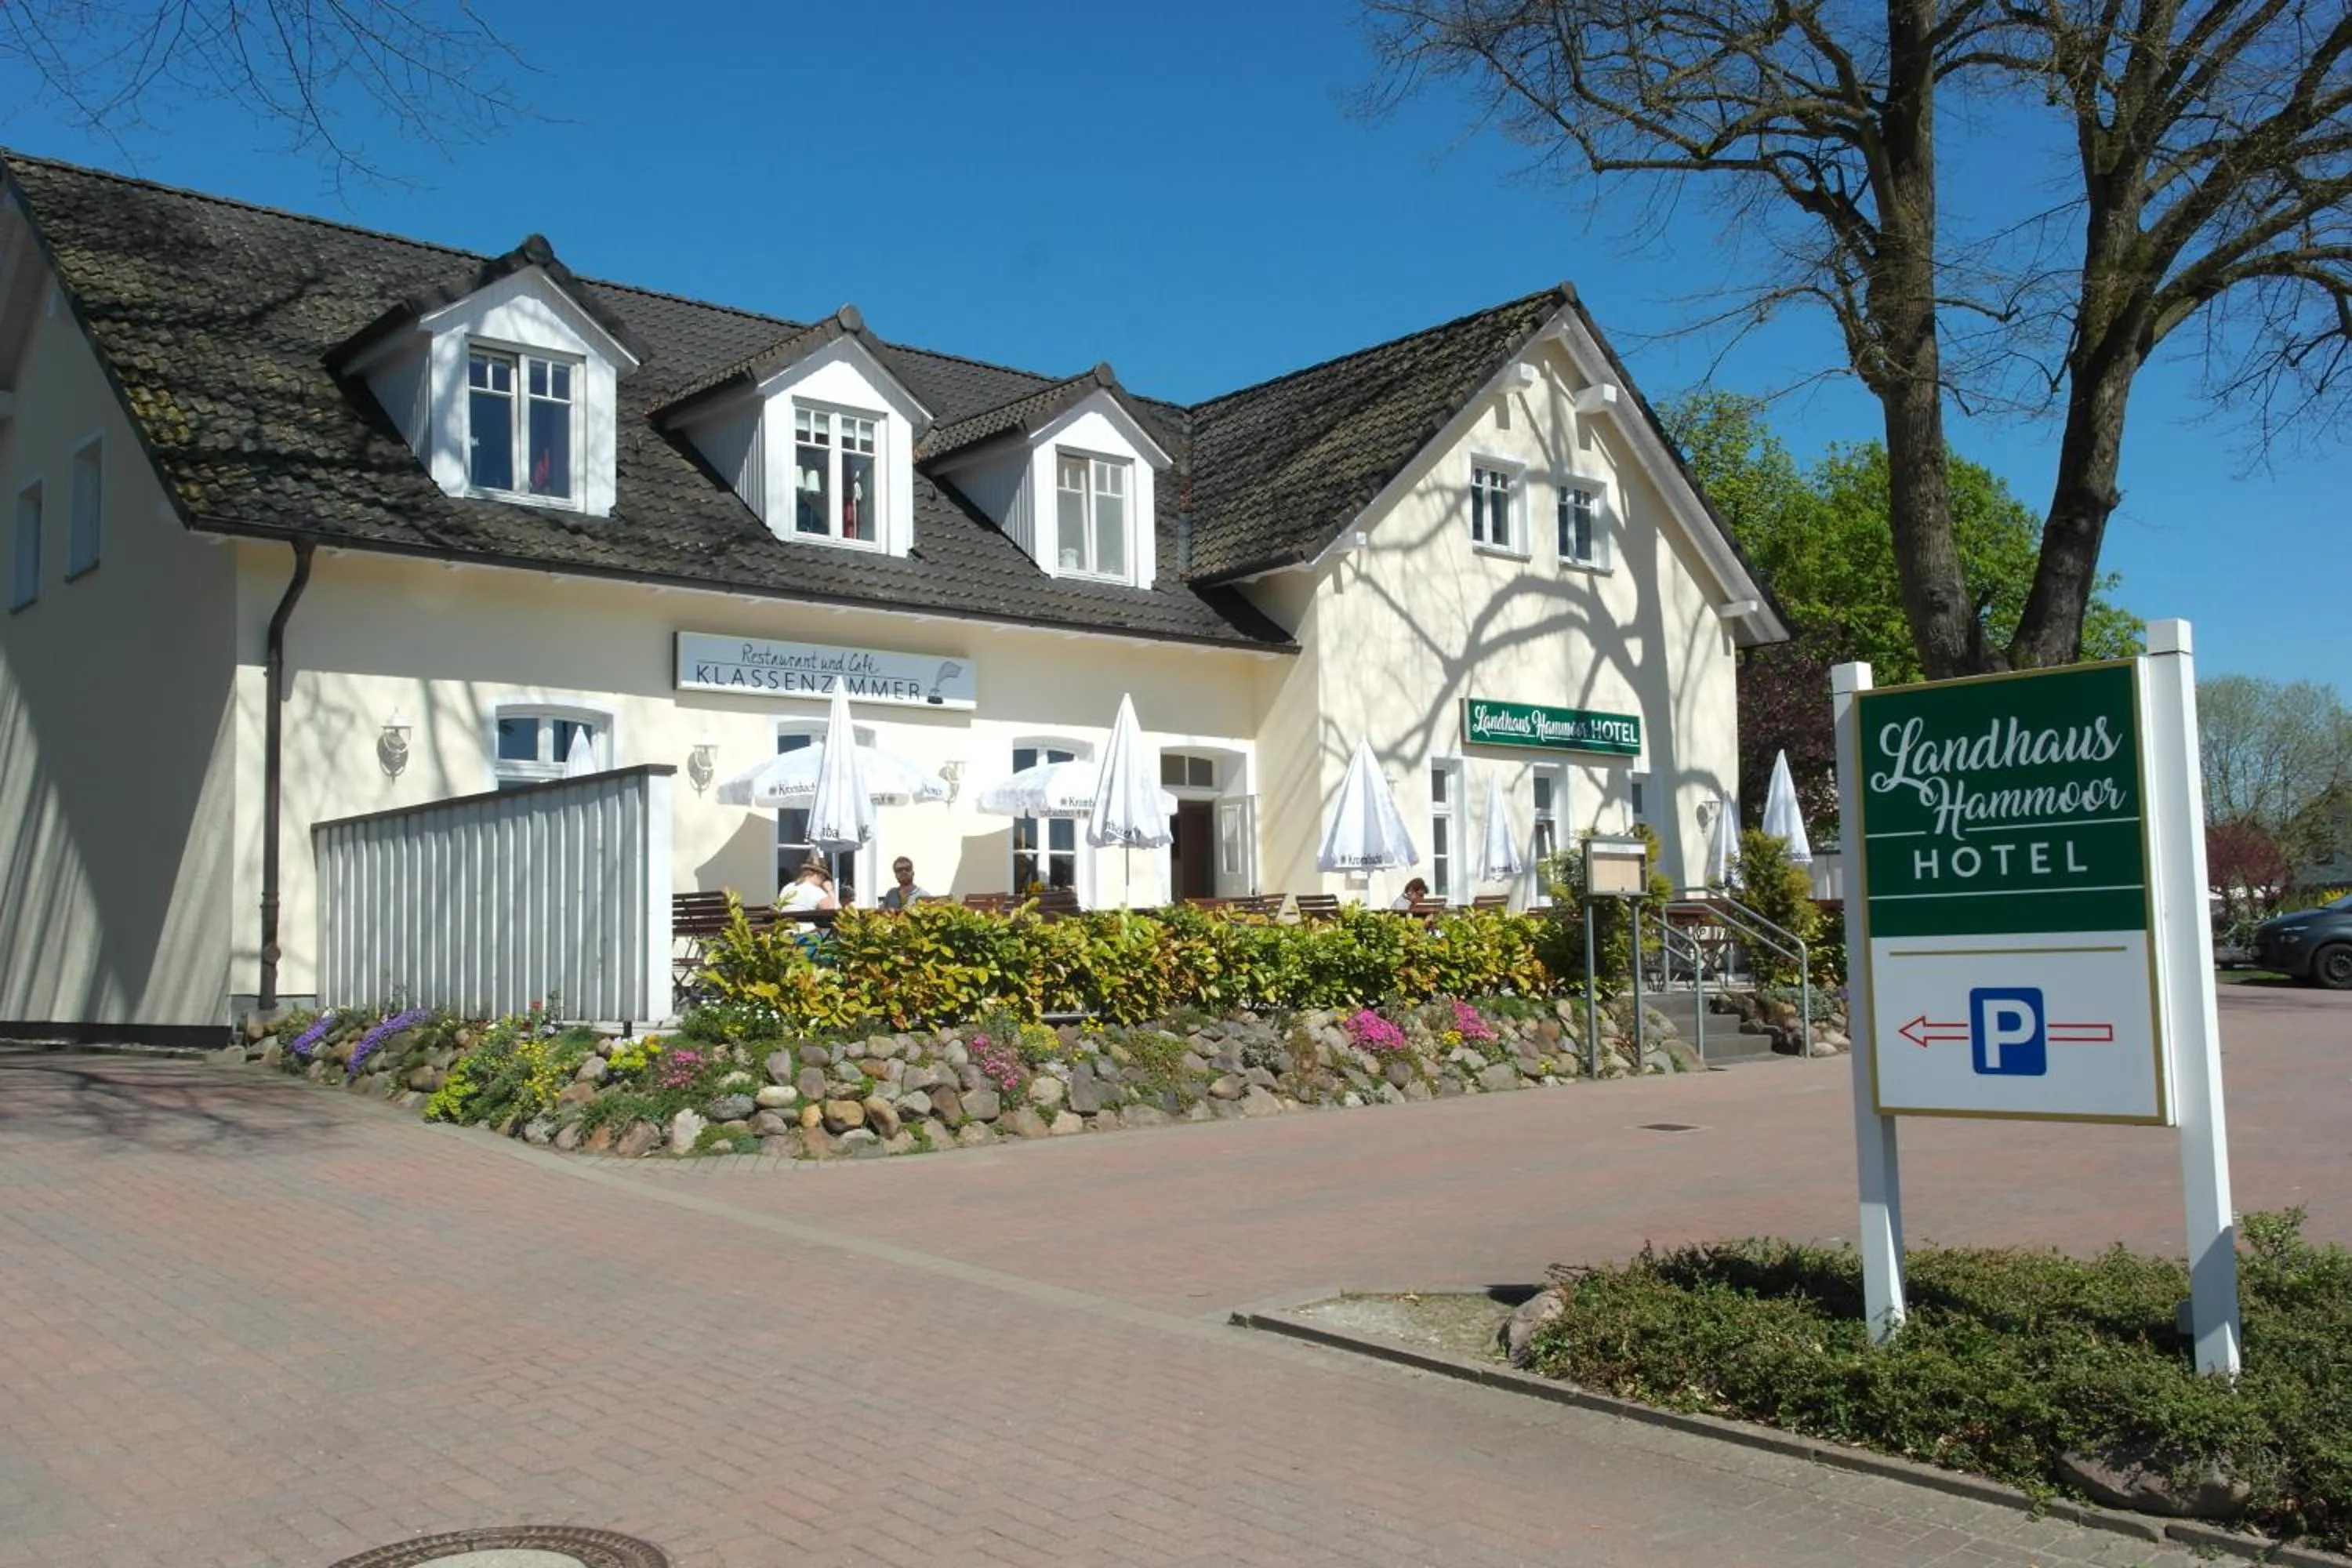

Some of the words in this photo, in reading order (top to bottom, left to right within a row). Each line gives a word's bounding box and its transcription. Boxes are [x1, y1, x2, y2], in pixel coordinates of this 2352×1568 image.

[742, 643, 817, 670] Restaurant
[821, 652, 845, 672] und
[696, 664, 920, 700] KLASSENZMMER
[1472, 705, 1531, 737] Landhaus
[1531, 710, 1587, 742] Hammoor
[1591, 719, 1638, 743] HOTEL
[1871, 715, 2122, 793] Landhaus
[1919, 775, 2126, 840] Hammoor
[1914, 840, 2088, 880] HOTEL
[1981, 999, 2036, 1069] P
